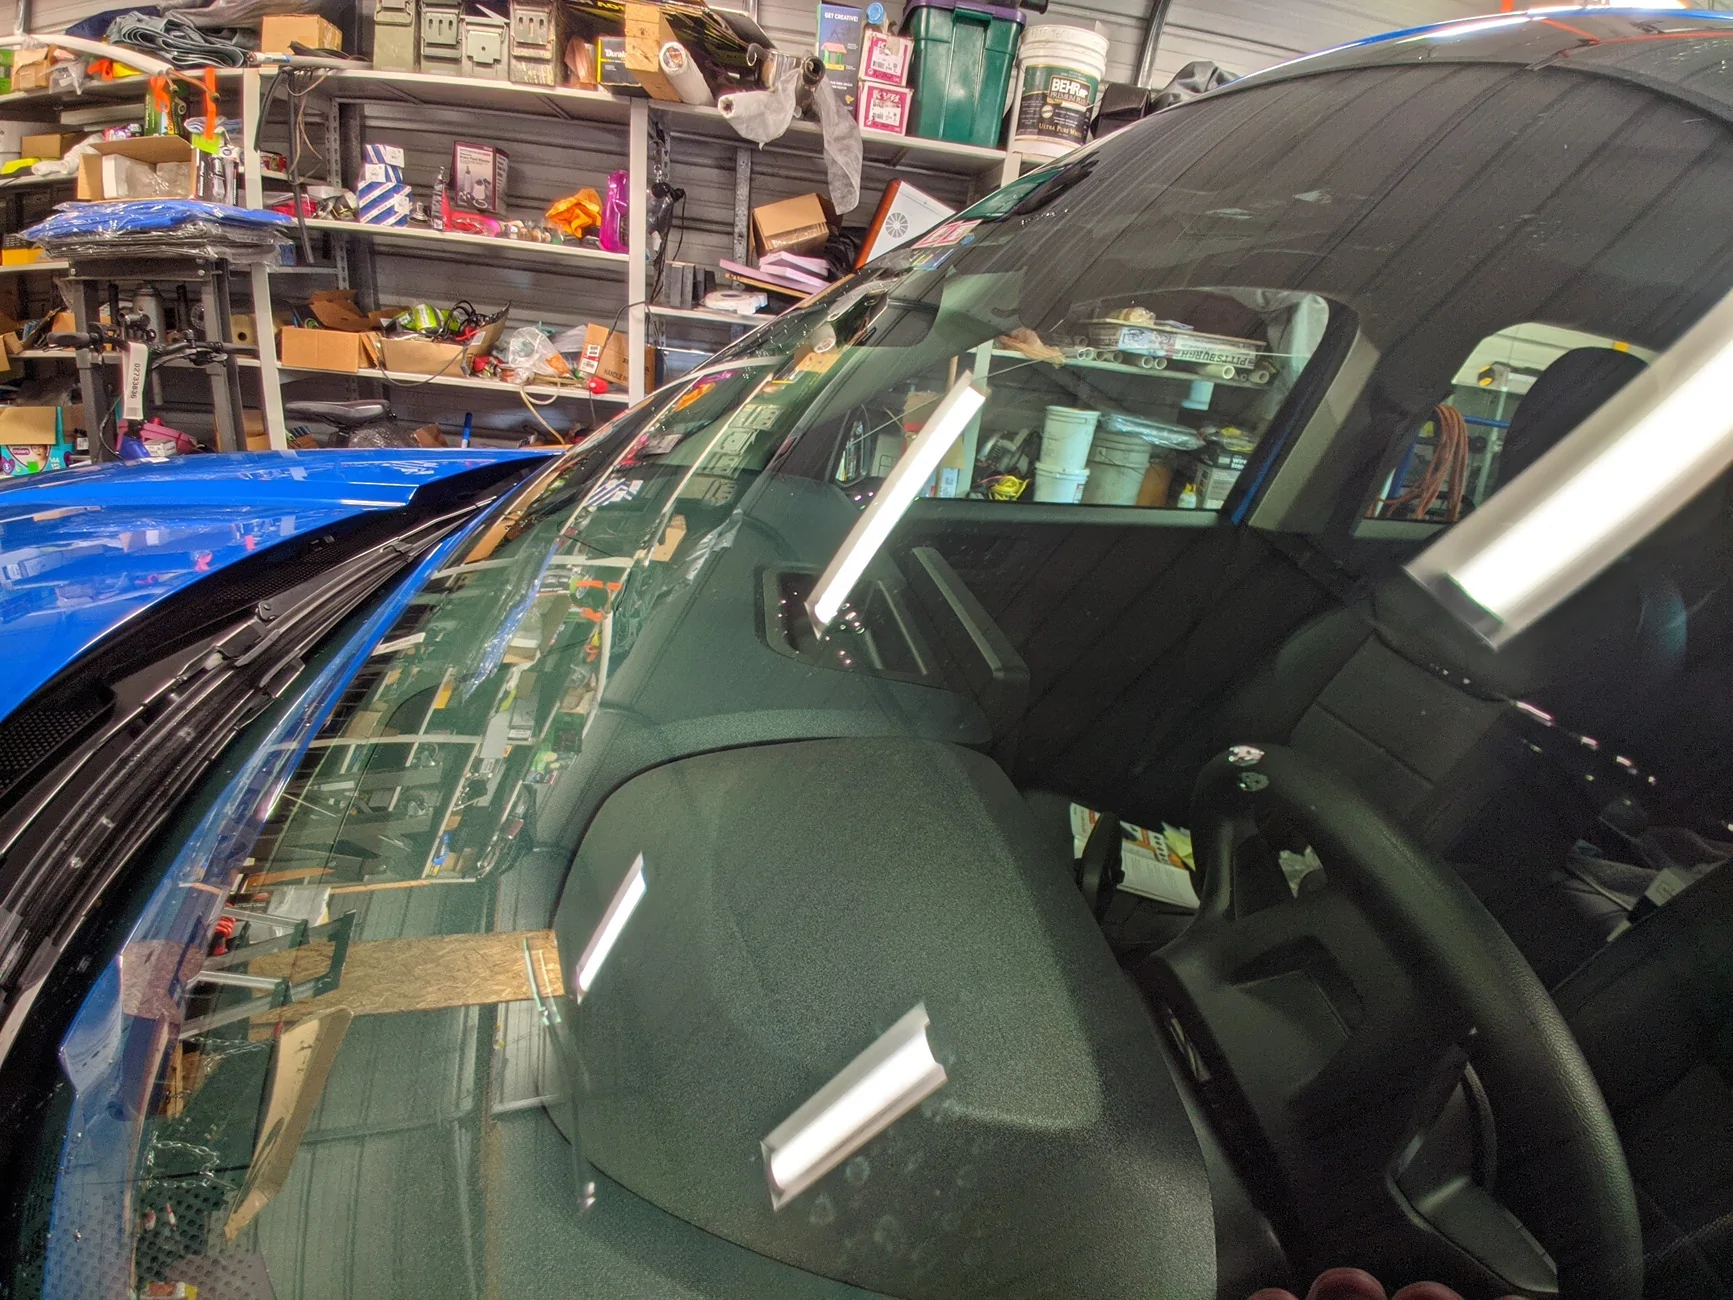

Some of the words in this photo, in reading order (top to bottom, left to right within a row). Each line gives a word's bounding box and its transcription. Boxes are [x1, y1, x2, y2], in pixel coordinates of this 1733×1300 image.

[835, 13, 859, 22] CREATIVE!
[1051, 78, 1080, 96] BEHR
[1050, 91, 1076, 102] PREMIUM
[1181, 350, 1249, 366] PITTSBURGH
[130, 363, 141, 399] 02733836
[604, 368, 623, 381] HANDLE
